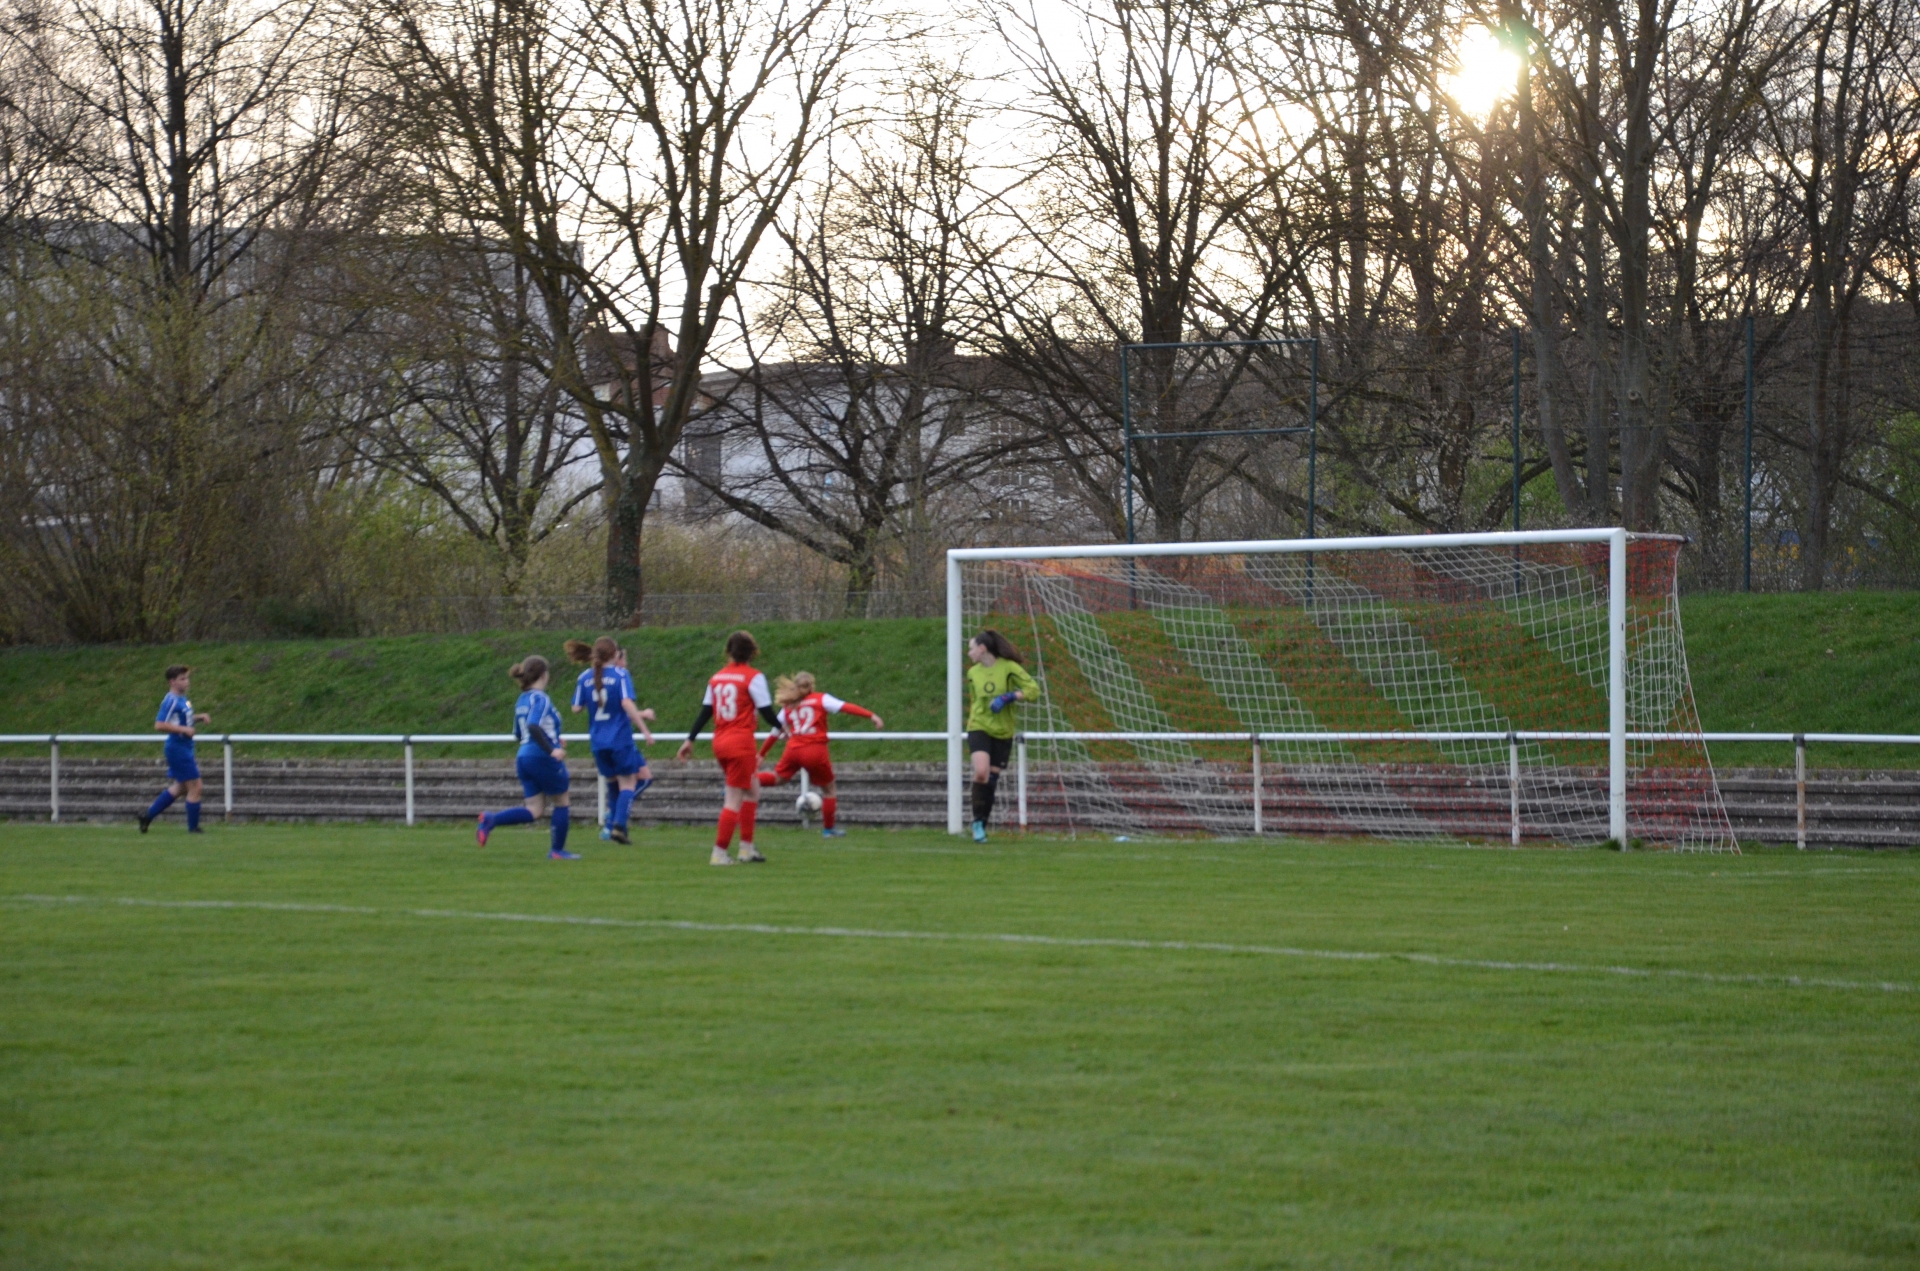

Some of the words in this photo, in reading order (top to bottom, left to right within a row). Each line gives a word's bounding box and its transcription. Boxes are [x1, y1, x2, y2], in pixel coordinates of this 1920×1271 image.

[592, 688, 611, 722] 2
[714, 682, 738, 721] 13
[789, 705, 817, 735] 12
